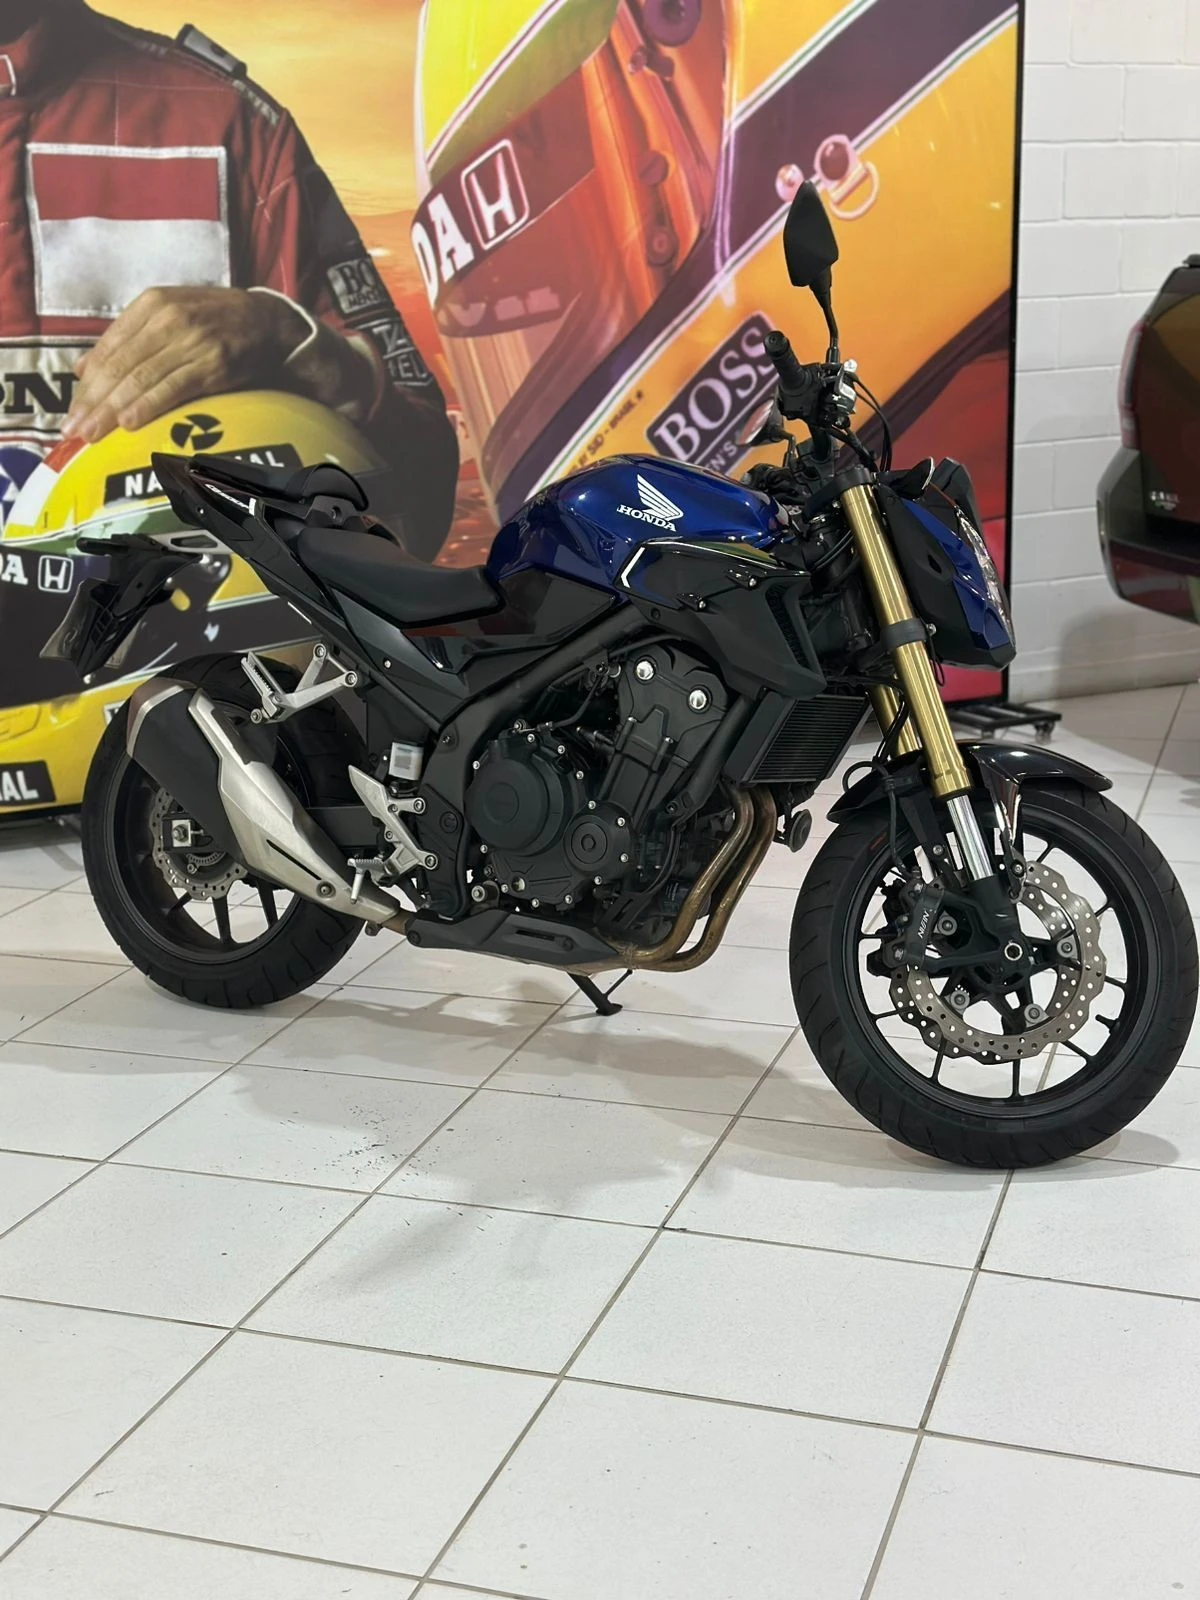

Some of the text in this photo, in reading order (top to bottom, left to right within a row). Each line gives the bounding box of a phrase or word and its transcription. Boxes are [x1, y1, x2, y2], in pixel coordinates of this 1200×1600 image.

[0, 372, 80, 414] N
[616, 504, 677, 532] HONDA
[0, 553, 29, 585] A
[0, 769, 39, 801] AL
